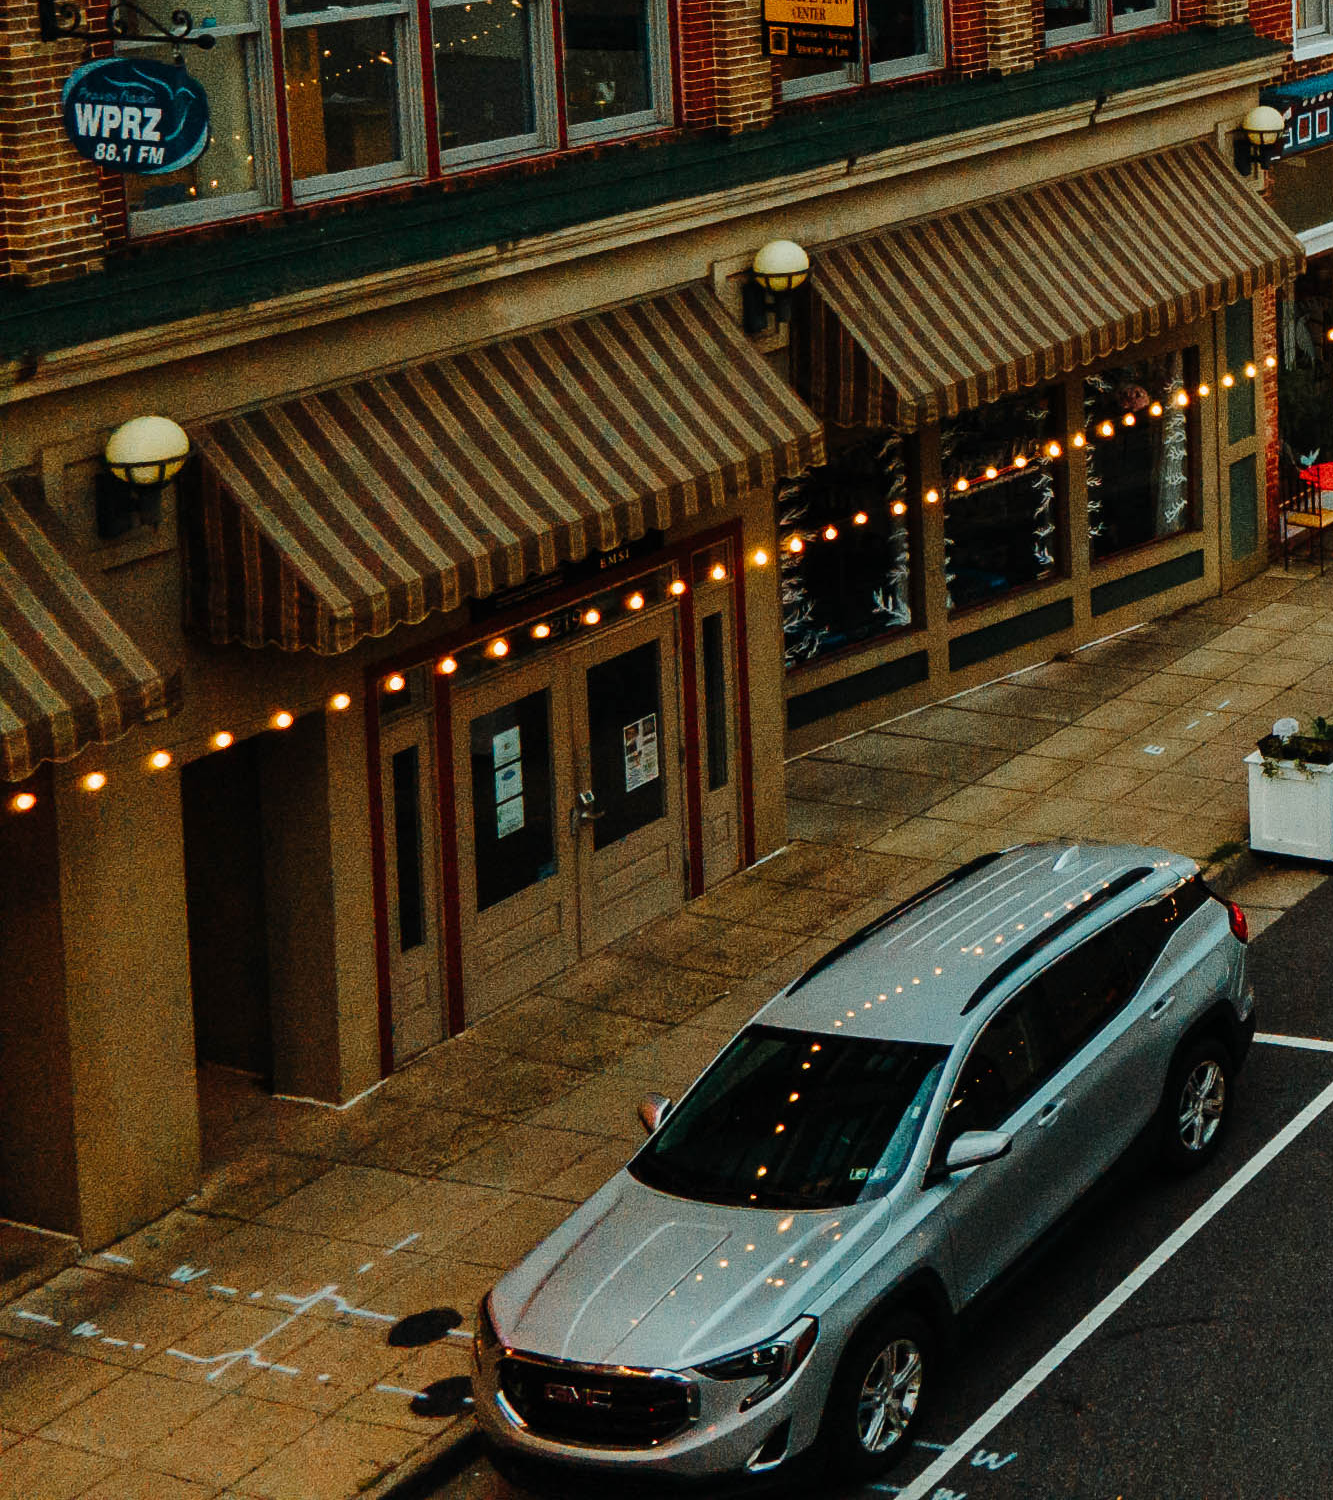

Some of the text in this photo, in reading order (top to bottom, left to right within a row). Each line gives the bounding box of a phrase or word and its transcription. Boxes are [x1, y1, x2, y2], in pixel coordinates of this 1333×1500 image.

[792, 6, 826, 21] CENTER
[74, 103, 163, 142] WPRZ
[94, 143, 165, 164] 88.1 FM
